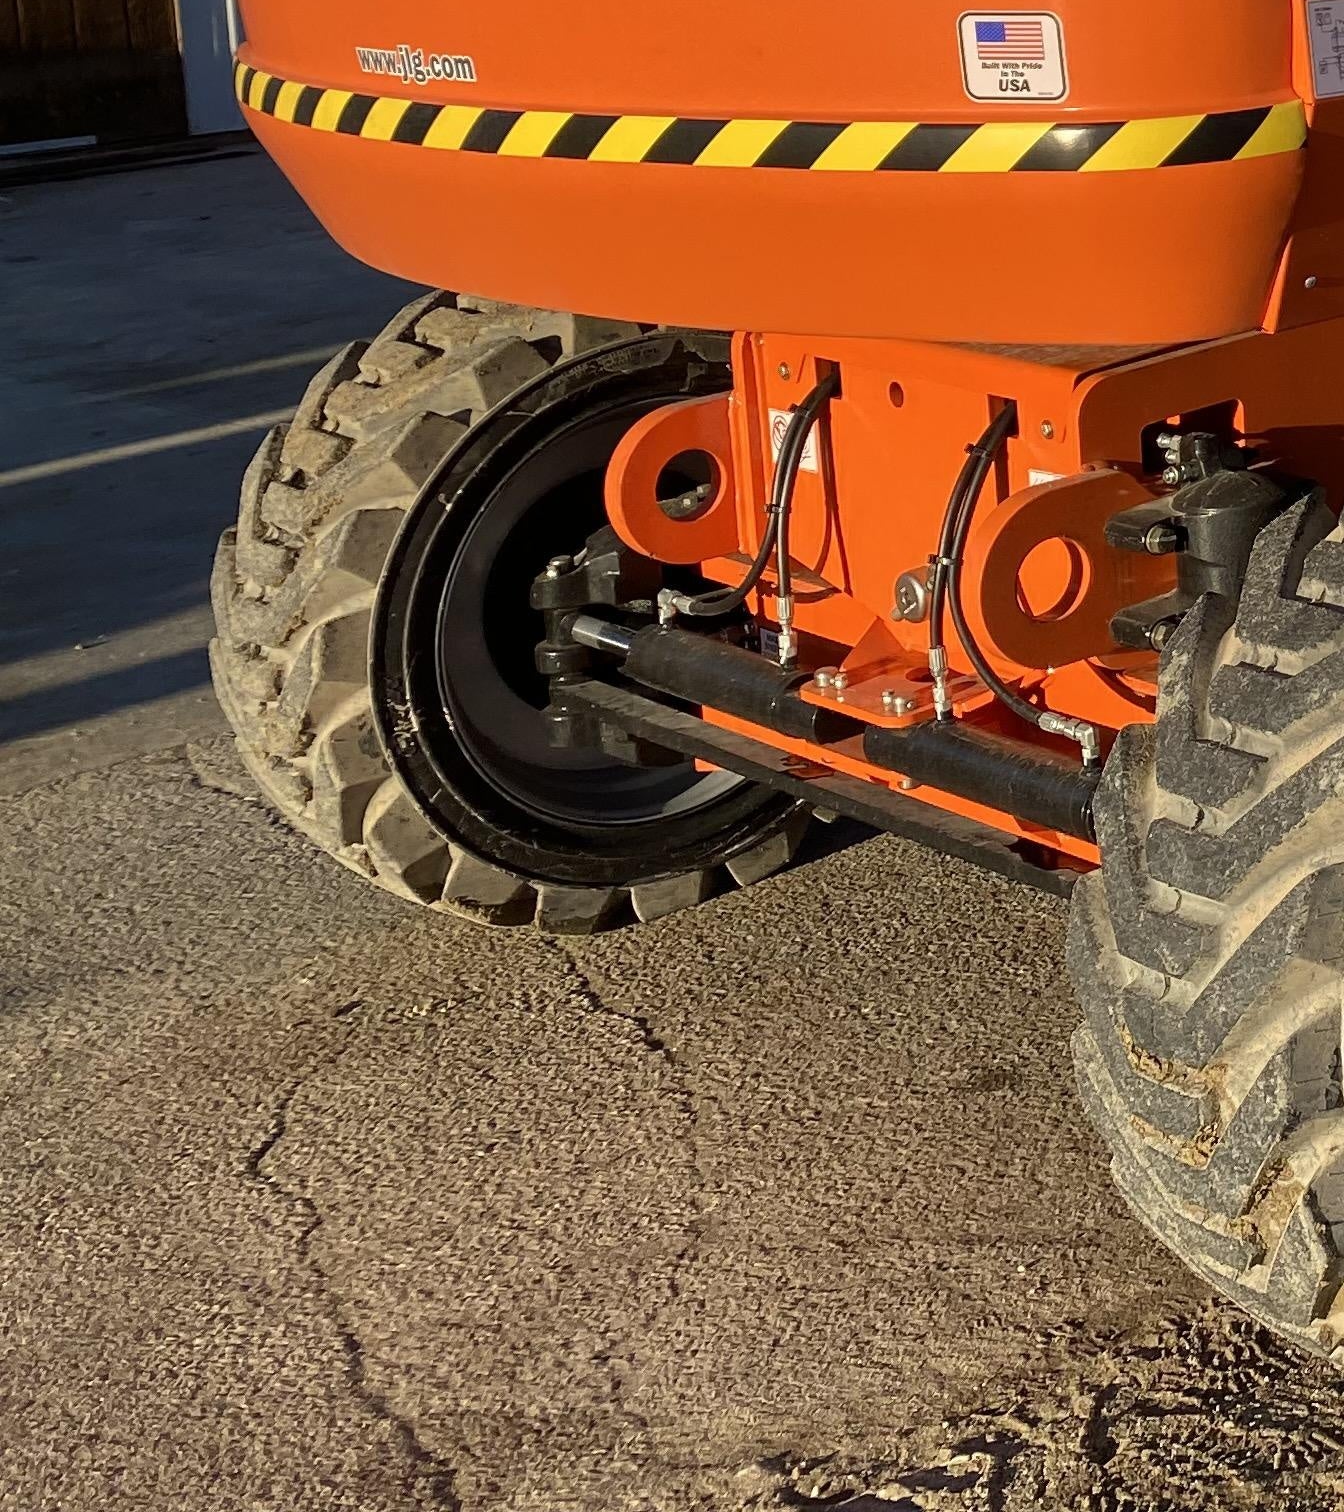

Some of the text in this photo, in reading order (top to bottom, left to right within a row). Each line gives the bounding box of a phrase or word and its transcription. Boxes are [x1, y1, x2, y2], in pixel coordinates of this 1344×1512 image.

[357, 46, 476, 83] www.jlg.com
[1021, 62, 1043, 70] Pride
[999, 78, 1031, 92] USA
